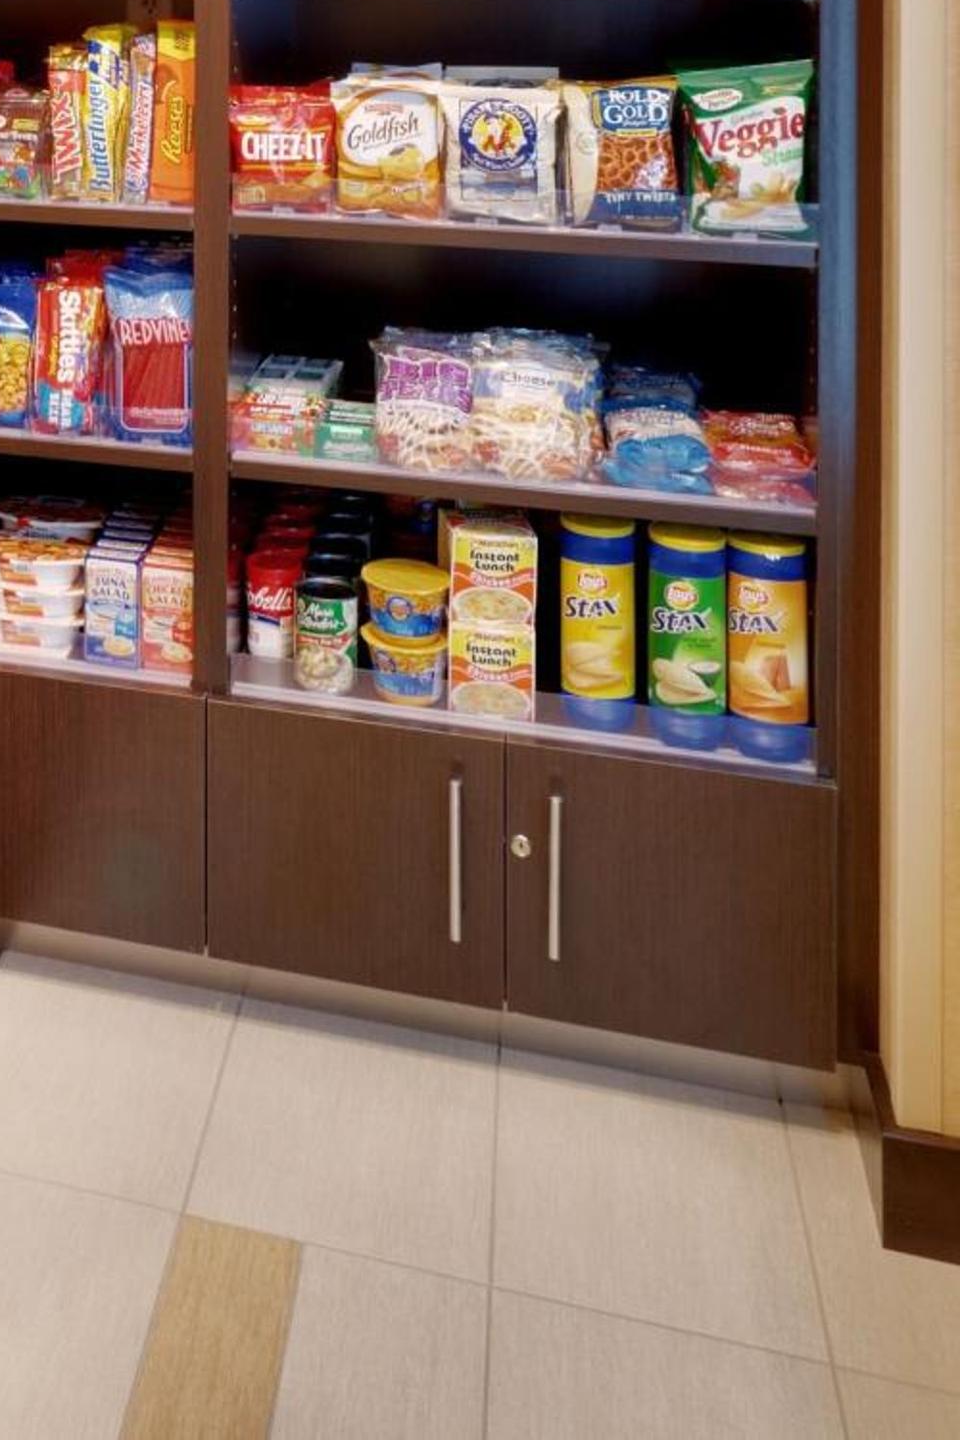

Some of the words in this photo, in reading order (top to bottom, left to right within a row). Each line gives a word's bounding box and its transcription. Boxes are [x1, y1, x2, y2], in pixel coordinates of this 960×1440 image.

[607, 89, 670, 105] ROLD
[604, 105, 667, 124] GOLD
[87, 79, 111, 192] Butterfinger
[346, 111, 420, 150] Goldfish
[694, 105, 805, 159] Veggie
[58, 289, 81, 383] Skittles
[470, 548, 520, 563] Instant
[474, 560, 515, 573] Lunch
[91, 587, 131, 601] SALAD
[465, 642, 517, 658] Instant
[471, 654, 512, 668] Lunch
